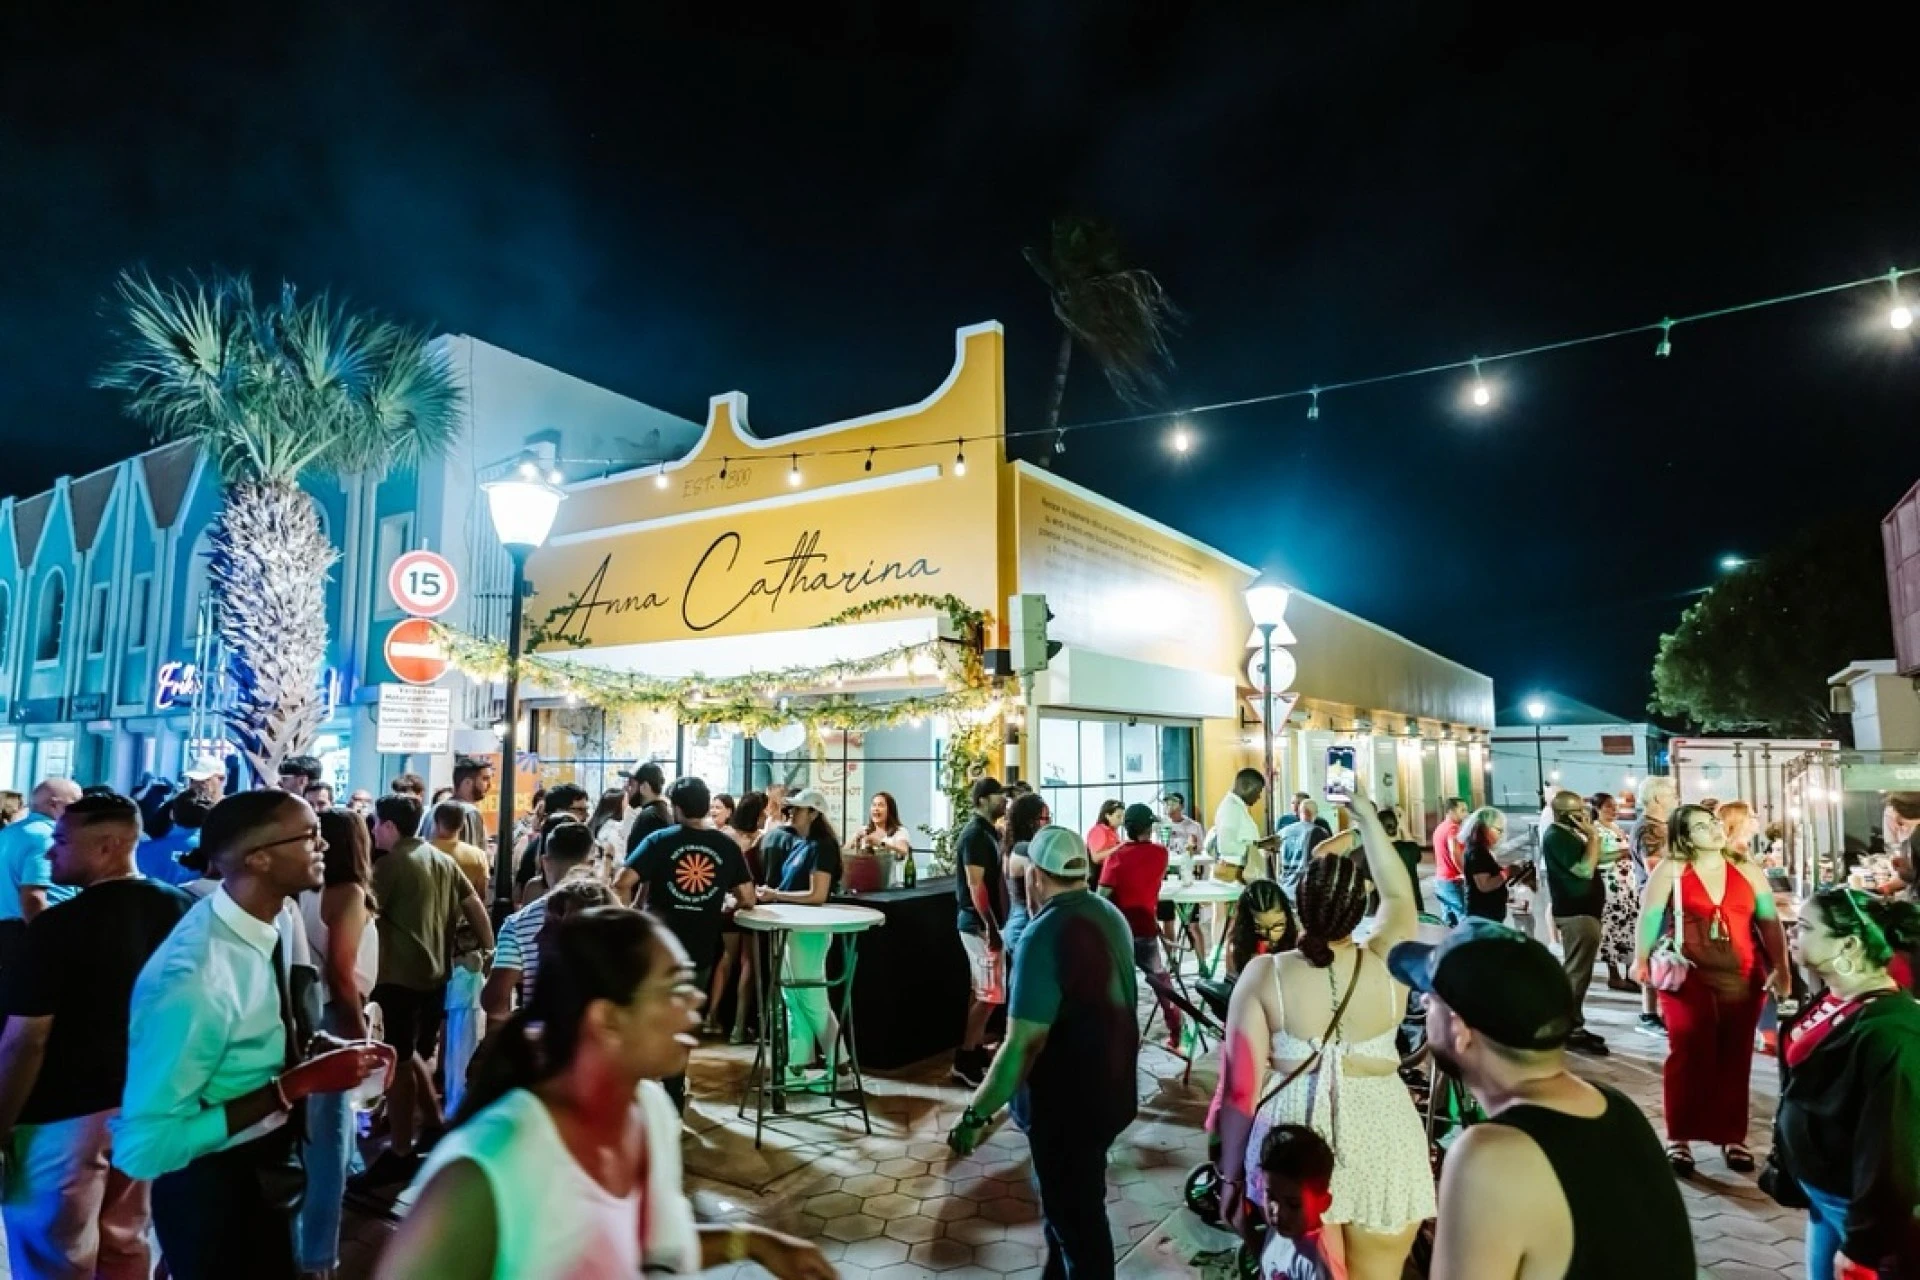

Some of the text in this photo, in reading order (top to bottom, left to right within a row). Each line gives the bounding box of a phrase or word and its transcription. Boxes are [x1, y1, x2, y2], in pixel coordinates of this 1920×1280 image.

[409, 571, 441, 596] 15
[557, 552, 670, 641] Anna
[681, 529, 942, 632] Catharina
